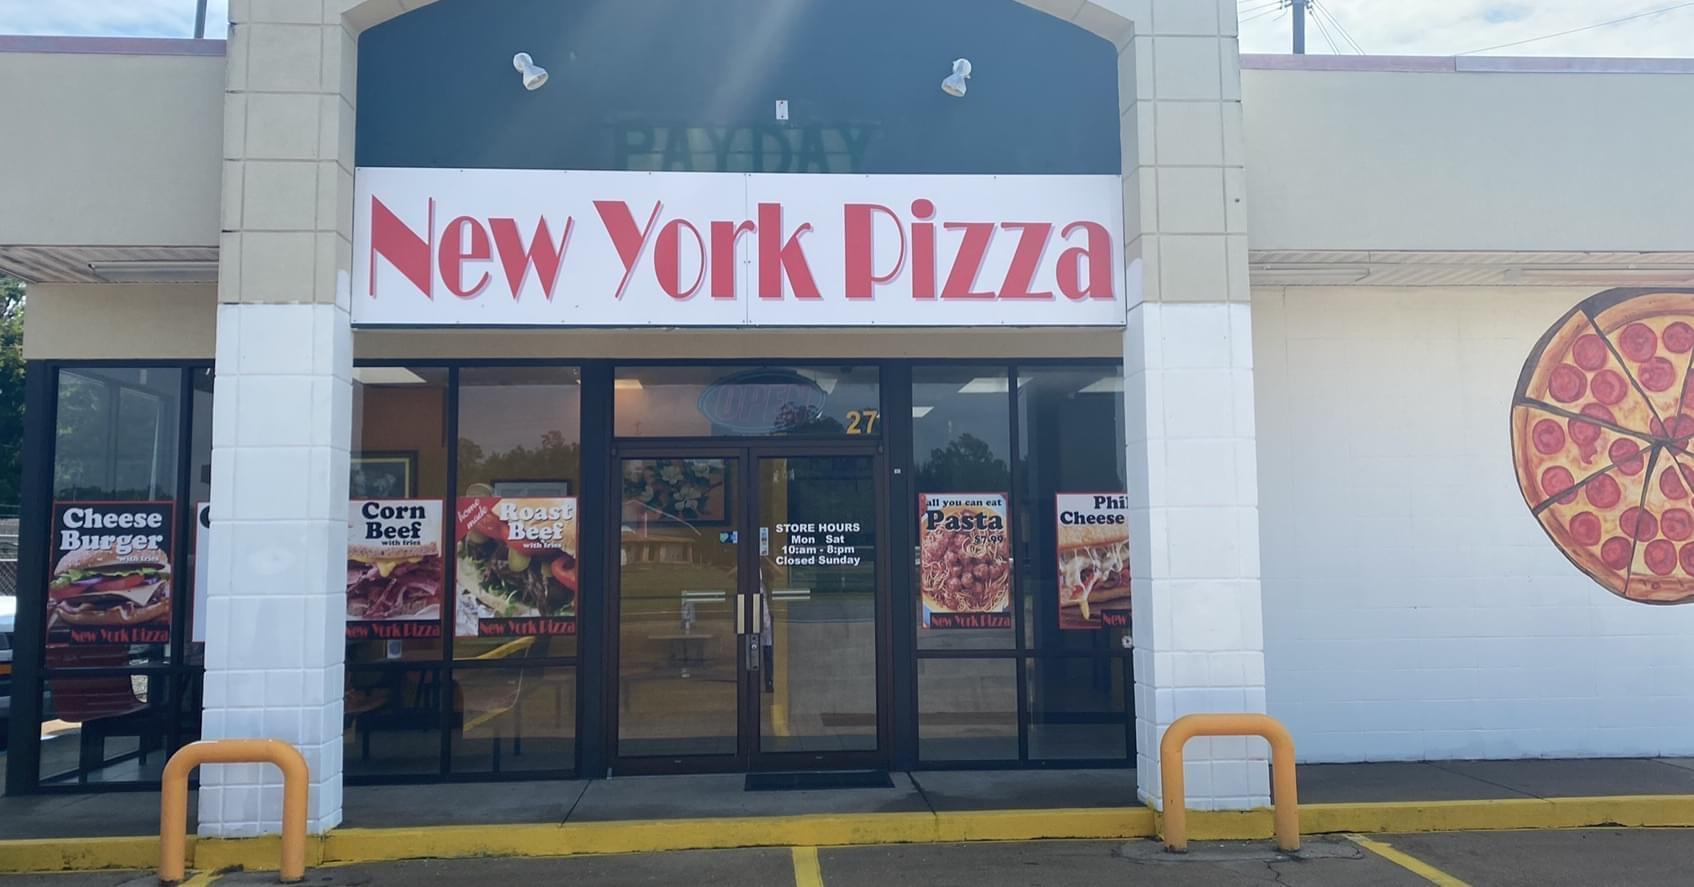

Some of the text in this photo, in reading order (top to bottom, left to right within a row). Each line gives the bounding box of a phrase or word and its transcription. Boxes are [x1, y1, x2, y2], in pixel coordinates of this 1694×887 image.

[614, 122, 869, 172] PAYDAY
[370, 193, 1116, 302] New York Pizza
[846, 410, 878, 434] 27
[361, 501, 426, 520] Corn
[457, 499, 480, 523] home
[499, 502, 574, 521] Roast
[926, 498, 1002, 508] all you can eat
[63, 508, 162, 528] Cheese
[466, 506, 489, 530] made
[775, 522, 861, 533] STORE HOURS
[926, 509, 1004, 531] Pasta
[1060, 511, 1124, 525] Cheese
[365, 521, 422, 540] Beef
[508, 522, 564, 541] Beef
[791, 534, 845, 544] Mon Sat
[974, 535, 1004, 545] $7.99
[60, 529, 164, 556] Burger
[523, 541, 543, 549] with
[782, 545, 817, 554] 10:am
[826, 544, 855, 555] 8:pm
[775, 555, 861, 567] Closed Sunday
[479, 619, 576, 635] New York Pizza
[1103, 613, 1128, 625] New
[71, 628, 169, 643] New York Pizza
